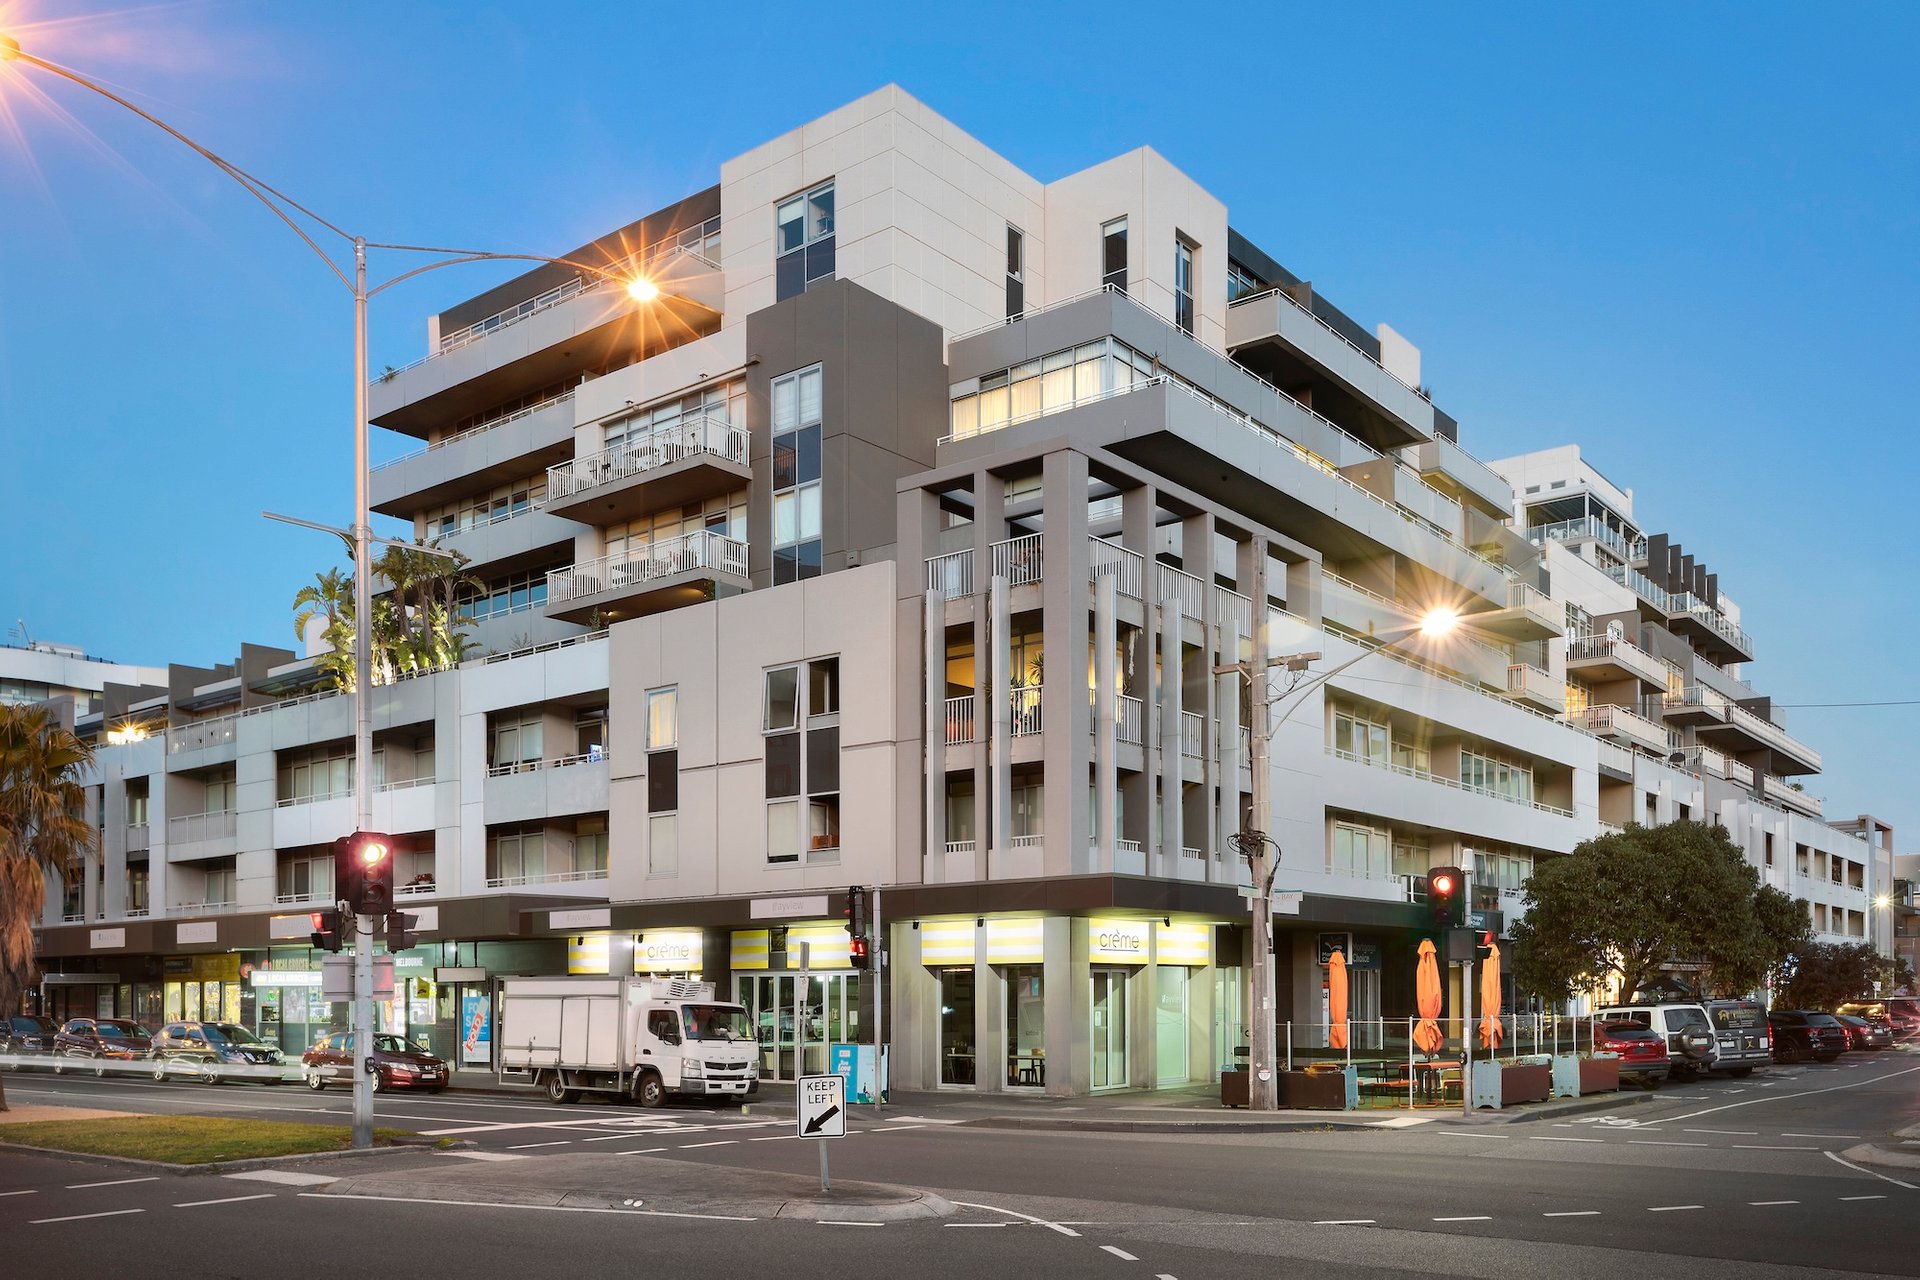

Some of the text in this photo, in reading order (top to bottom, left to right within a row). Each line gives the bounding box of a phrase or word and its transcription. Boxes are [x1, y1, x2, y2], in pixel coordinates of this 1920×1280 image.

[465, 1015, 488, 1028] SE
[806, 1081, 836, 1092] KEEP
[808, 1093, 835, 1104] LEFT
